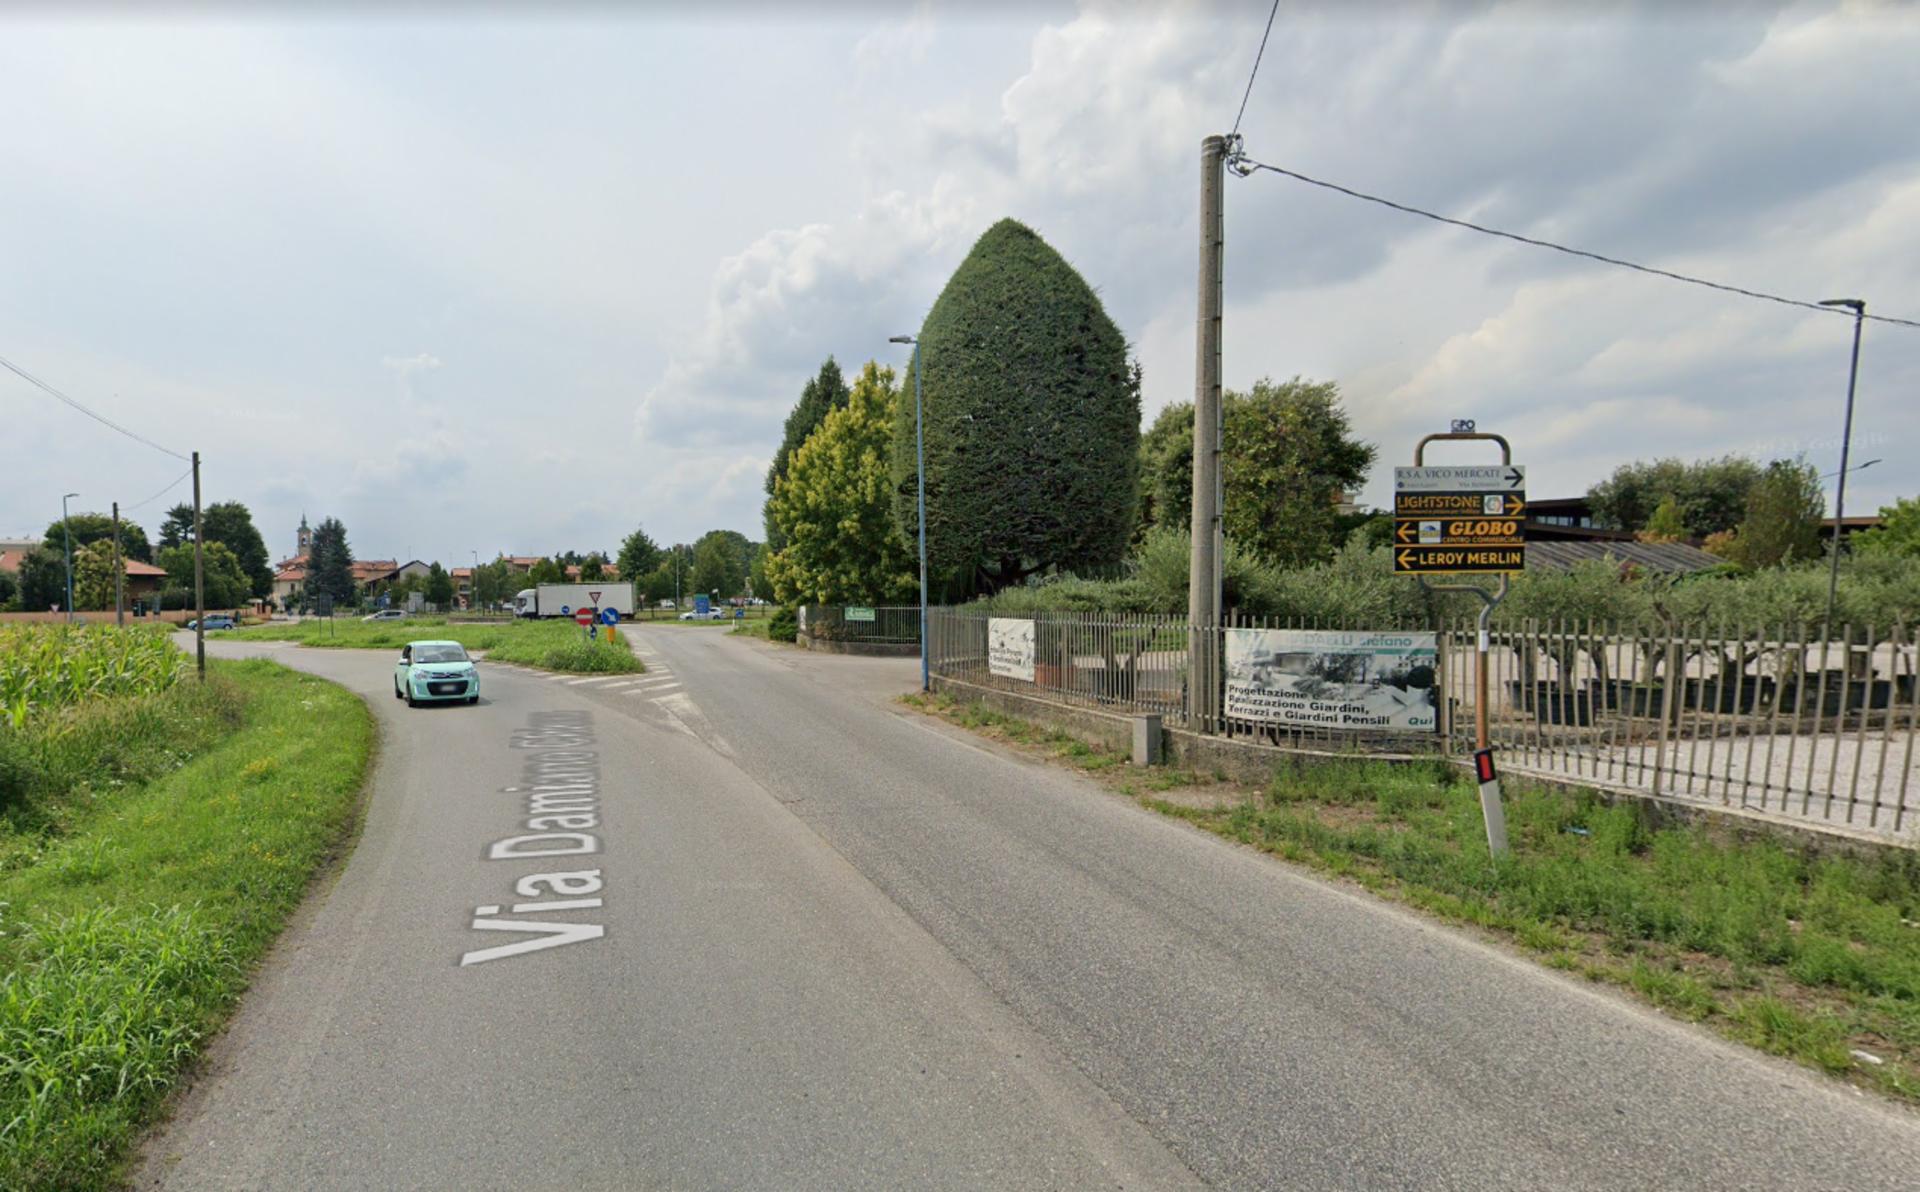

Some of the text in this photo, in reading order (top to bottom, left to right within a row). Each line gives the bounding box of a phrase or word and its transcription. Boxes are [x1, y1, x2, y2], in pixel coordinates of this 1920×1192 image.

[1425, 469, 1451, 479] VICO
[1397, 496, 1481, 508] LIGHTSTONE
[1449, 521, 1517, 536] GLOBO
[1419, 552, 1521, 565] LEROY MERLIN
[1228, 684, 1308, 699] Progettazione
[1228, 704, 1270, 717] Terrazzi
[1285, 710, 1338, 723] Giardini
[1343, 714, 1390, 725] Pensili
[1310, 702, 1370, 715] Giardini,
[1408, 716, 1433, 726] Qui
